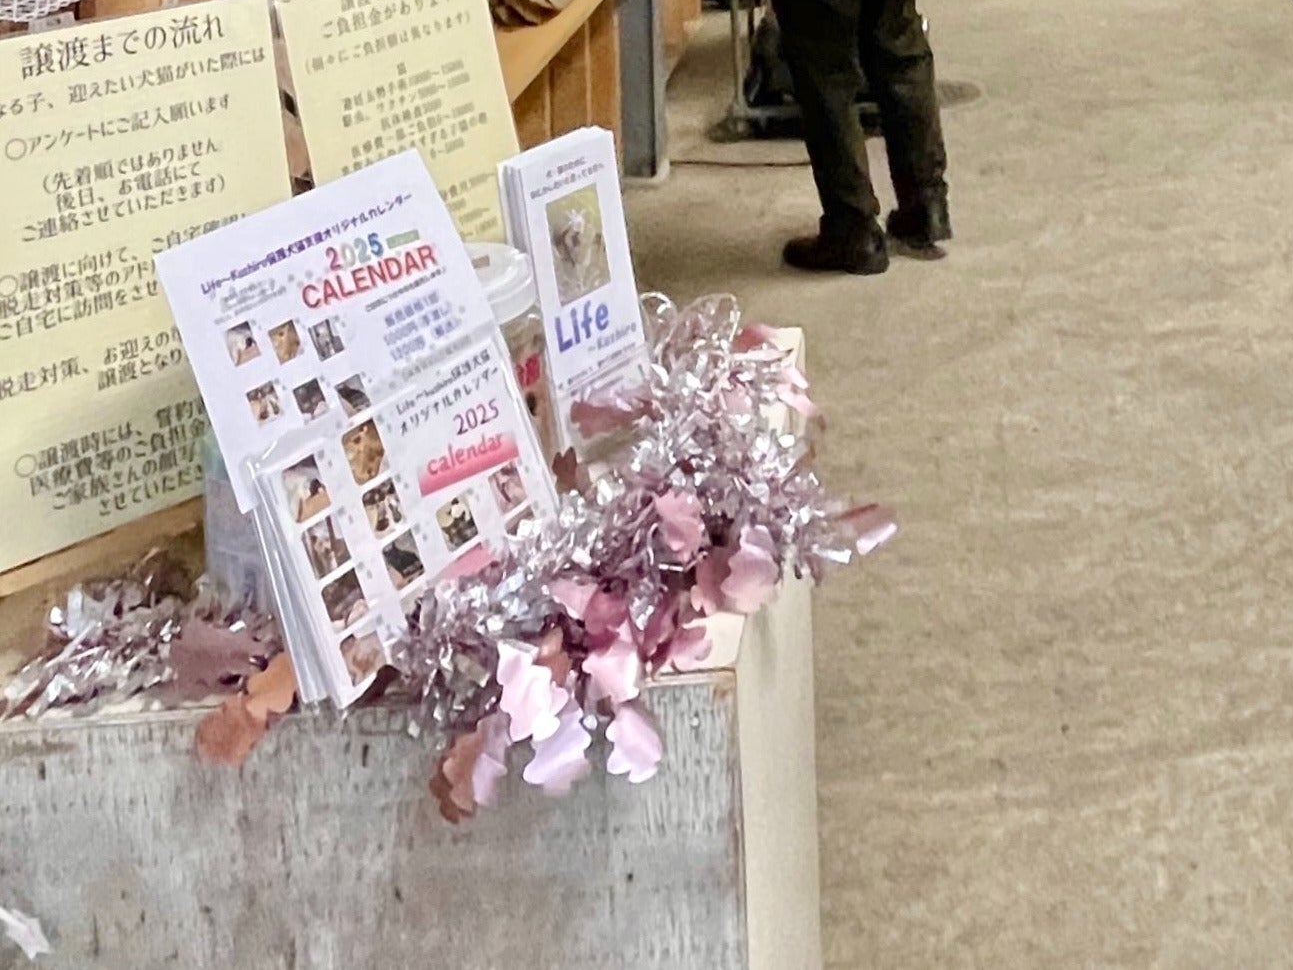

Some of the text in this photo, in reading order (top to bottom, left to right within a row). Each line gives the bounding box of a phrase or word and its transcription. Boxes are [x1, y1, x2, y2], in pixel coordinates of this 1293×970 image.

[19, 14, 225, 80] 譲渡までの流れ
[301, 243, 439, 310] CALENDAR
[326, 231, 385, 273] 2025
[0, 259, 156, 320] 脱走対策等のアド
[554, 300, 610, 354] Life
[453, 398, 501, 436] 2025
[426, 432, 504, 477] calendar
